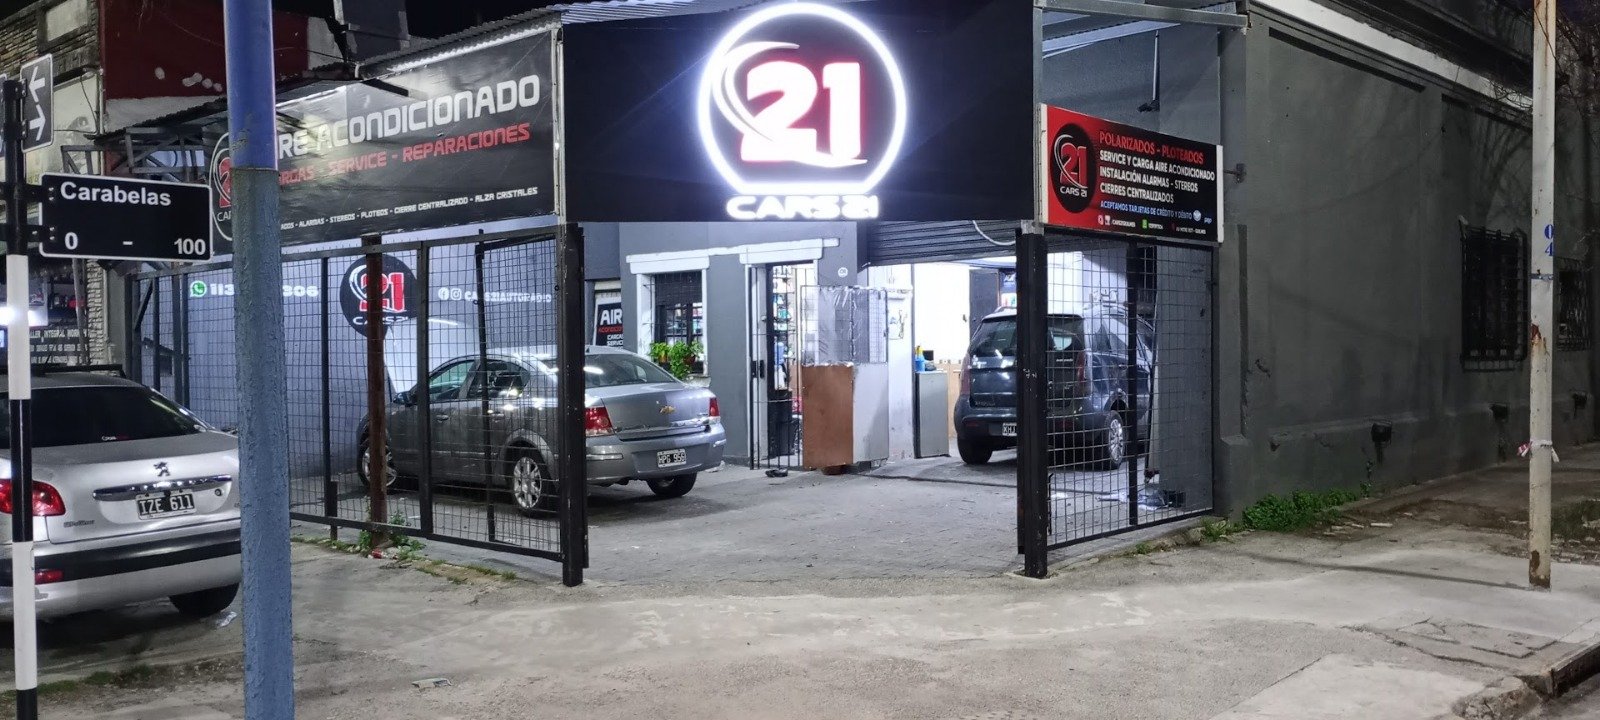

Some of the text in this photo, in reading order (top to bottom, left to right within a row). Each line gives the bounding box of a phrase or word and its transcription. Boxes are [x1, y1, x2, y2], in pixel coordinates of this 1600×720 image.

[316, 74, 540, 151] ACONDICIONADO
[741, 61, 861, 162] 21
[279, 168, 315, 186] RGAS
[328, 150, 387, 176] SERVICE
[402, 122, 530, 162] REPARACIONES
[1100, 131, 1155, 155] POLARIZADOS
[1162, 144, 1204, 164] PLOTEADOS
[1059, 143, 1087, 186] 21
[1099, 150, 1215, 181] SERVICE Y CARGA AIRE ACONDICIONADO
[1060, 186, 1088, 197] CARS 21
[1100, 166, 1141, 182] INSTALACIÓN
[1142, 173, 1169, 188] ALARMAS
[1174, 180, 1198, 193] STEREOS
[60, 181, 172, 206] Carabelas
[1100, 182, 1174, 204] CIERRES CENTRALIZADOS
[298, 217, 325, 228] ALARMAS
[329, 213, 356, 223] STEREOS
[361, 208, 389, 219] PLOTEOS
[394, 204, 417, 214] CIERRE
[418, 197, 469, 211] CENTRALIZADO
[475, 193, 495, 203] ALZA
[496, 187, 538, 200] CRISTALES
[726, 195, 879, 219] CARS 21
[1100, 200, 1128, 212] ACEPTAMOS
[1128, 205, 1151, 215] TARJETAS
[1151, 207, 1157, 216] DE
[64, 232, 78, 250] 0
[174, 238, 206, 255] 100
[464, 290, 552, 303] CAS21AUTORADIO
[139, 495, 194, 515] IZE 611
